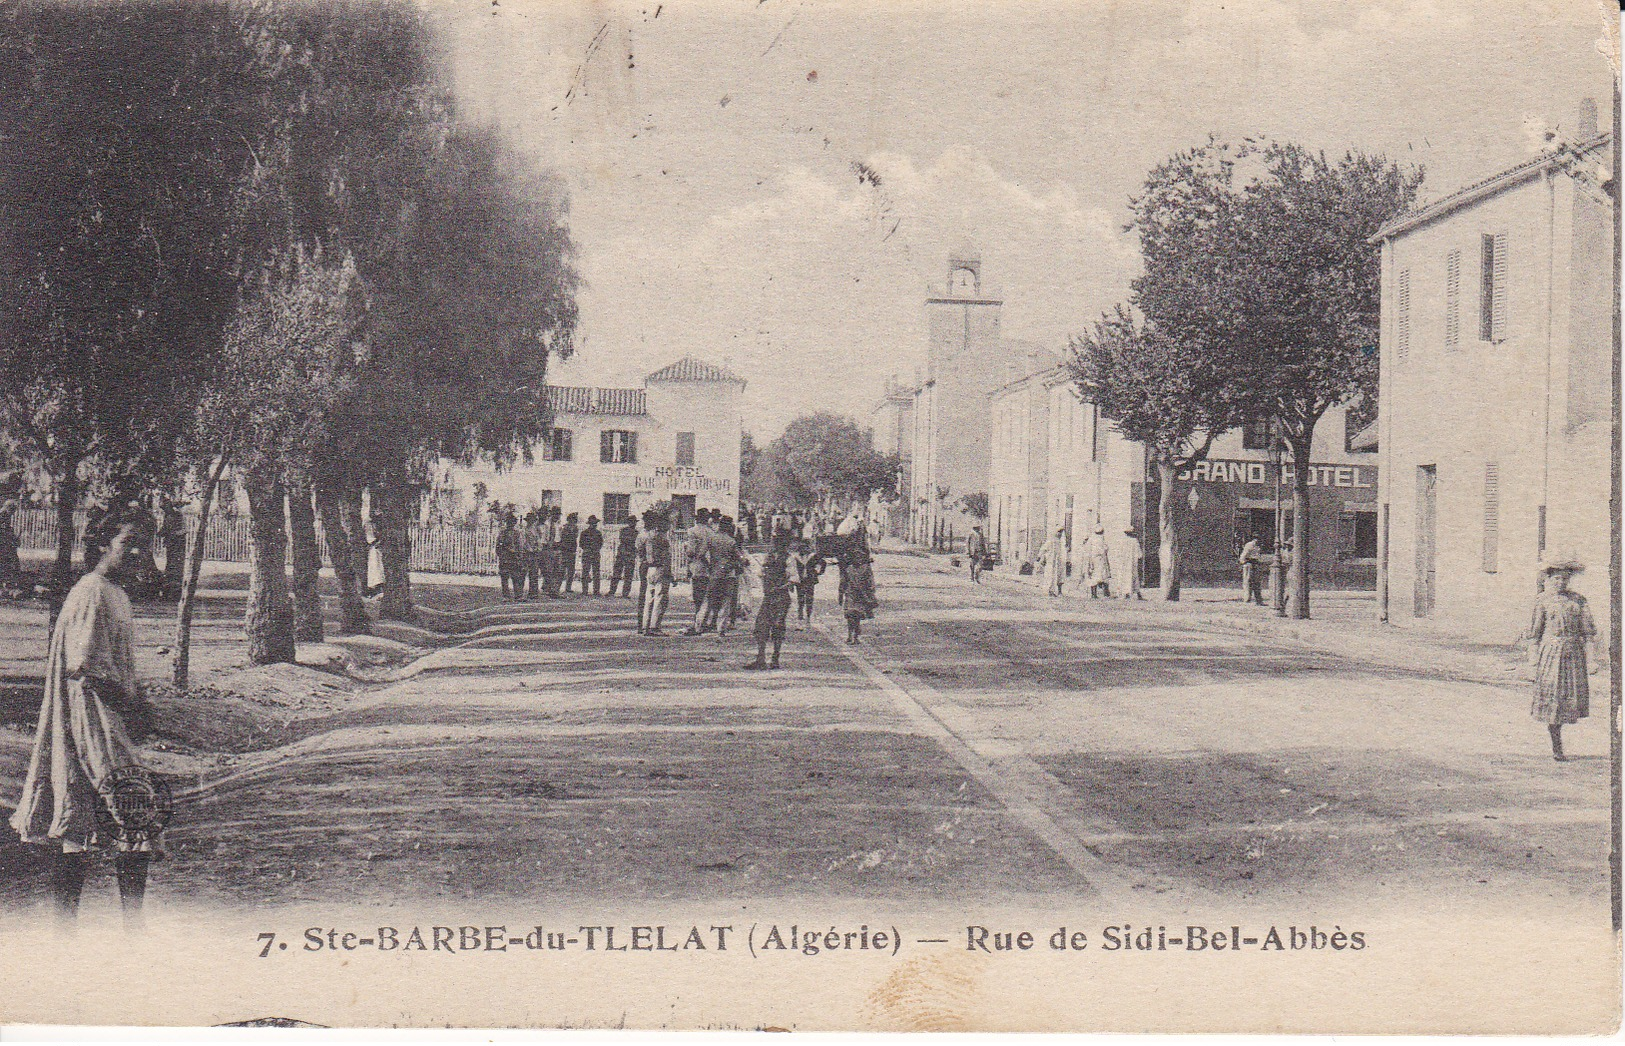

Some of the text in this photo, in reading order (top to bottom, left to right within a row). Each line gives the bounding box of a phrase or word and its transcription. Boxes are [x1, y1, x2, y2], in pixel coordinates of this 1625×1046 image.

[655, 466, 705, 478] HOTEL
[1281, 464, 1371, 488] HOTEL
[635, 476, 655, 489] BAR
